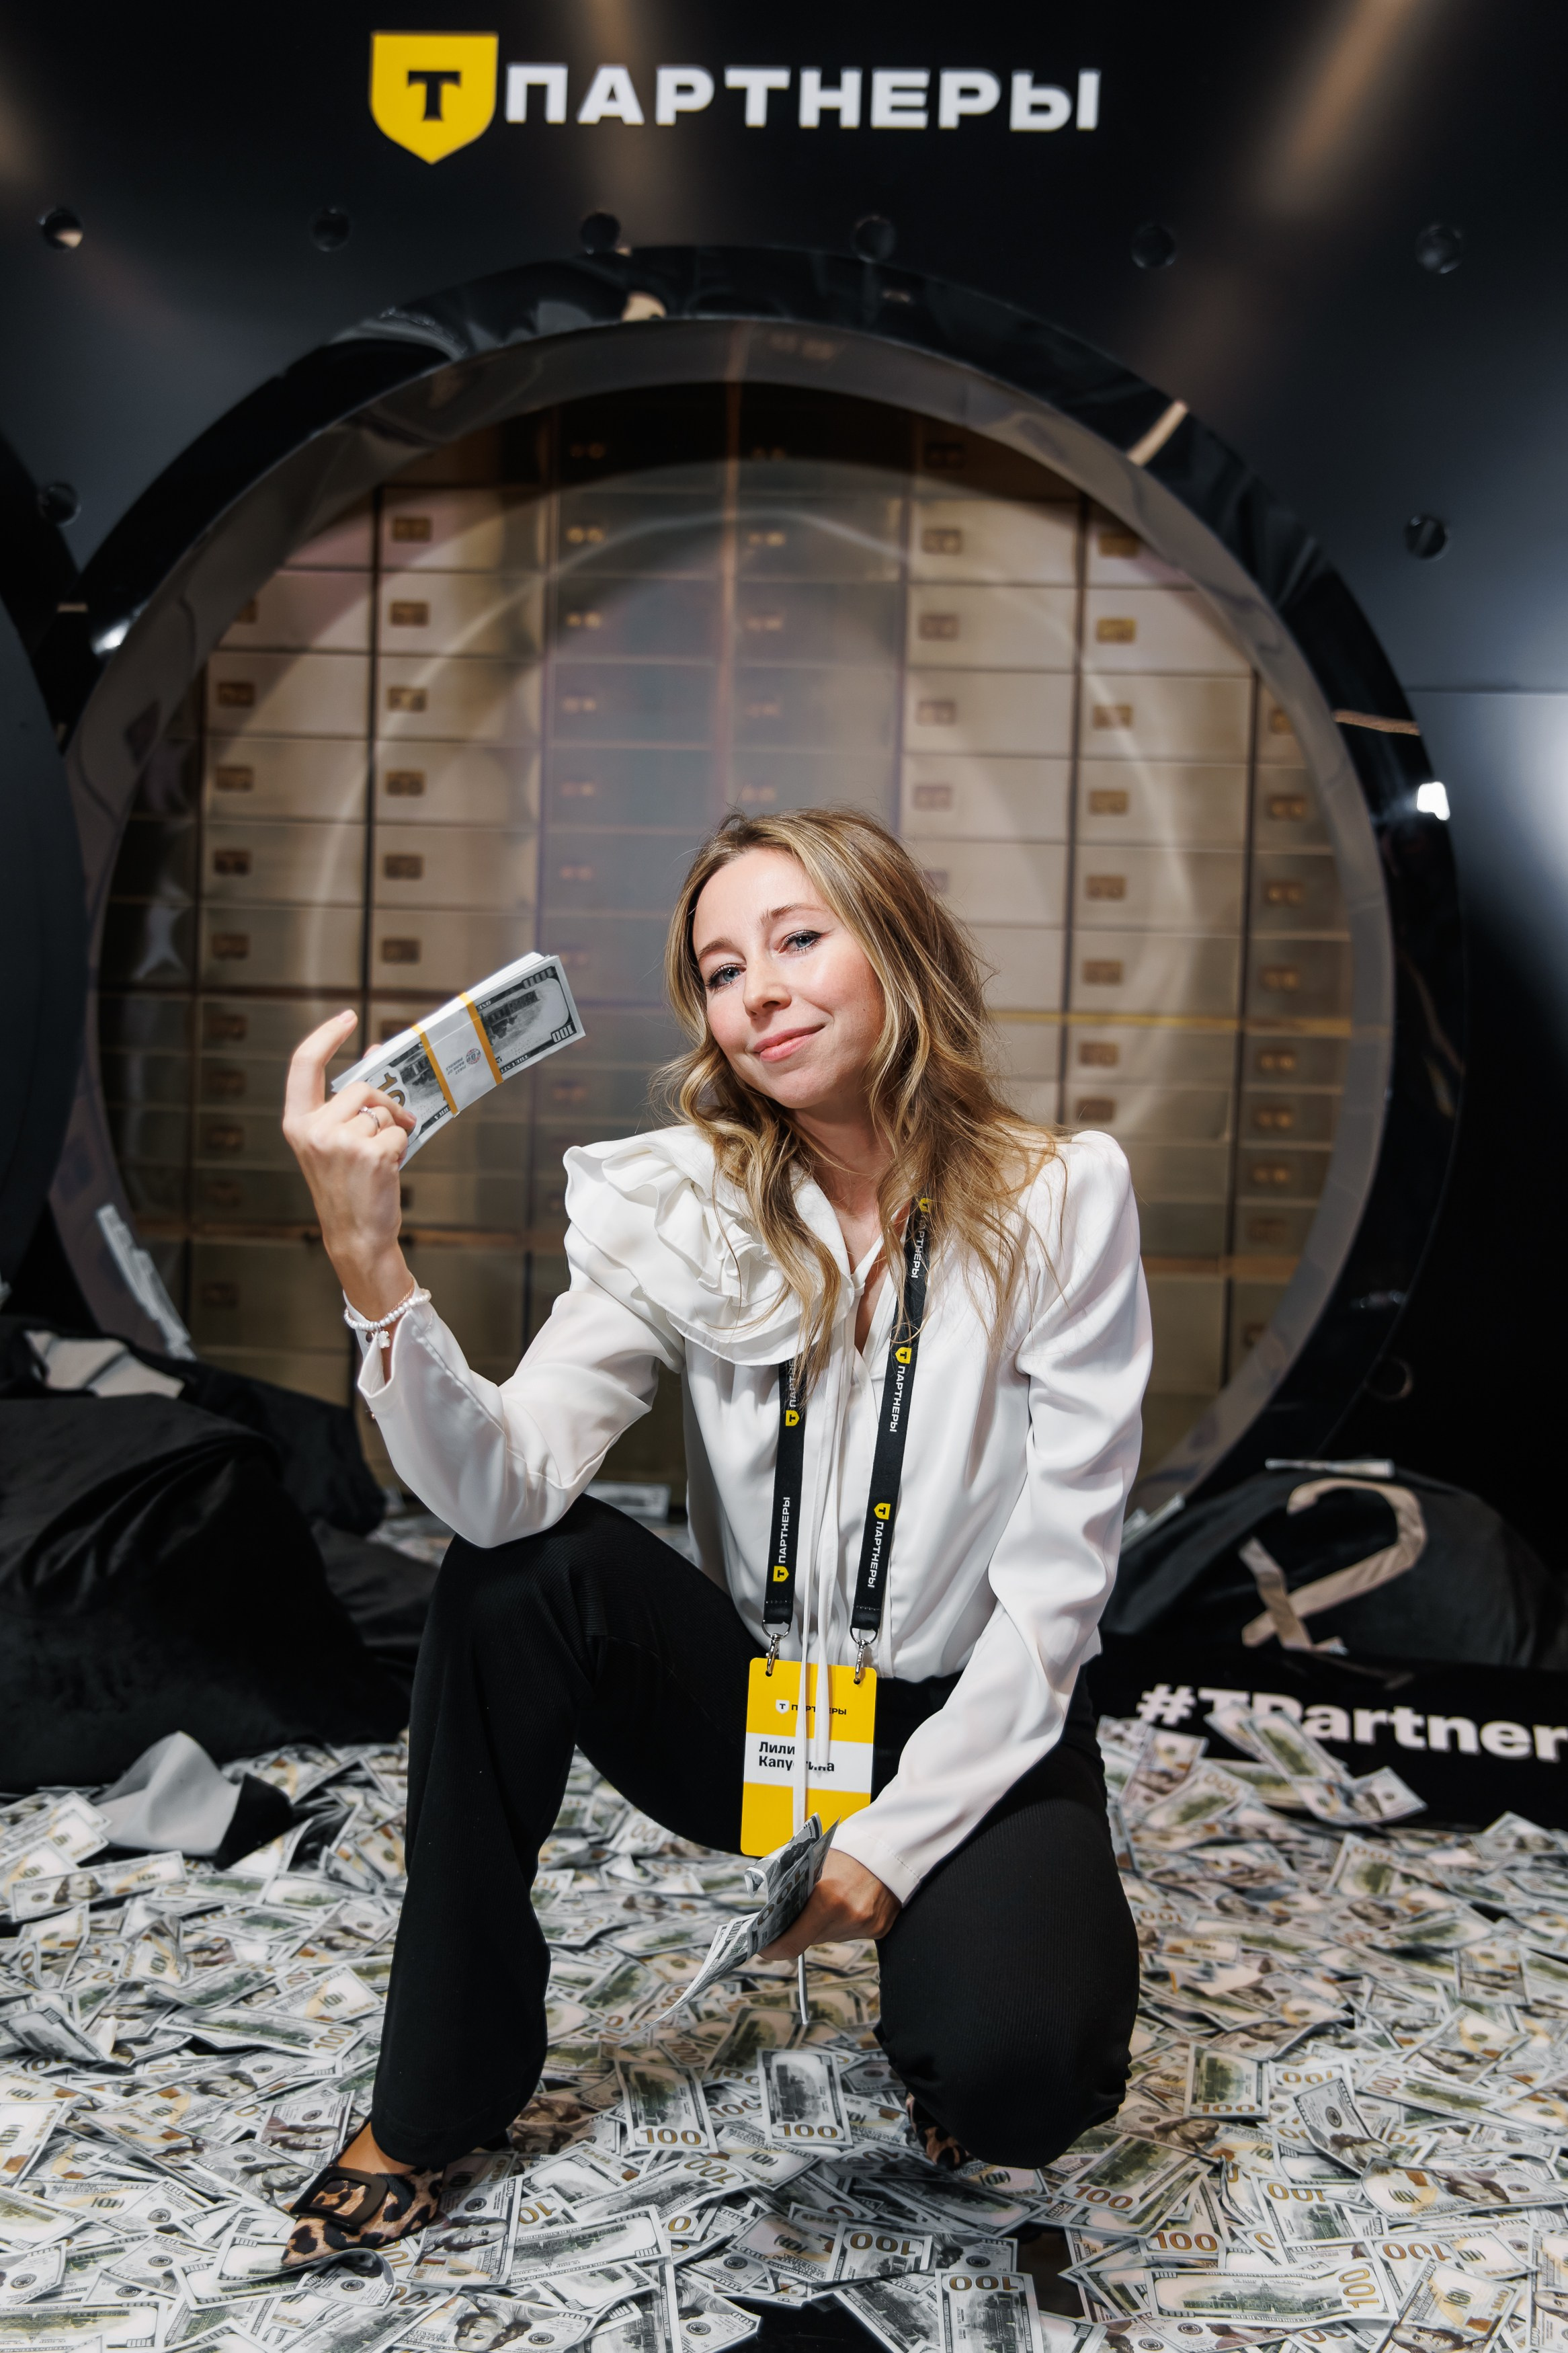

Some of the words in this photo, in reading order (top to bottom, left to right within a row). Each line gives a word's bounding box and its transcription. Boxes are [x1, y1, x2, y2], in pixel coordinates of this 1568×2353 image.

[505, 63, 1102, 132] ПАРТНЕРЫ
[552, 1024, 574, 1043] 100
[889, 1365, 906, 1432] ПАРТНЕРЫ
[778, 1497, 790, 1564] ПАРТНЕРЫ
[868, 1521, 884, 1589] ПАРТНЕРЫ
[791, 1704, 847, 1715] ПРТЕРЫ
[314, 2027, 354, 2050] 100
[667, 2040, 705, 2063] 100
[1366, 2075, 1403, 2096] 100
[1199, 2104, 1255, 2114] 100
[639, 2127, 702, 2145] 100
[777, 2123, 838, 2139] 100
[684, 2159, 738, 2184] 100
[165, 2182, 186, 2198] 100
[1073, 2185, 1133, 2209] 100
[670, 2193, 697, 2212] DOLLARS
[155, 2235, 182, 2246] 100
[850, 2232, 916, 2255] 100
[1153, 2231, 1218, 2251] 100
[1382, 2242, 1452, 2261] 100
[1421, 2262, 1437, 2281] 100
[949, 2274, 1019, 2291] 100
[1338, 2268, 1380, 2309] 100
[1531, 2325, 1541, 2346] 100
